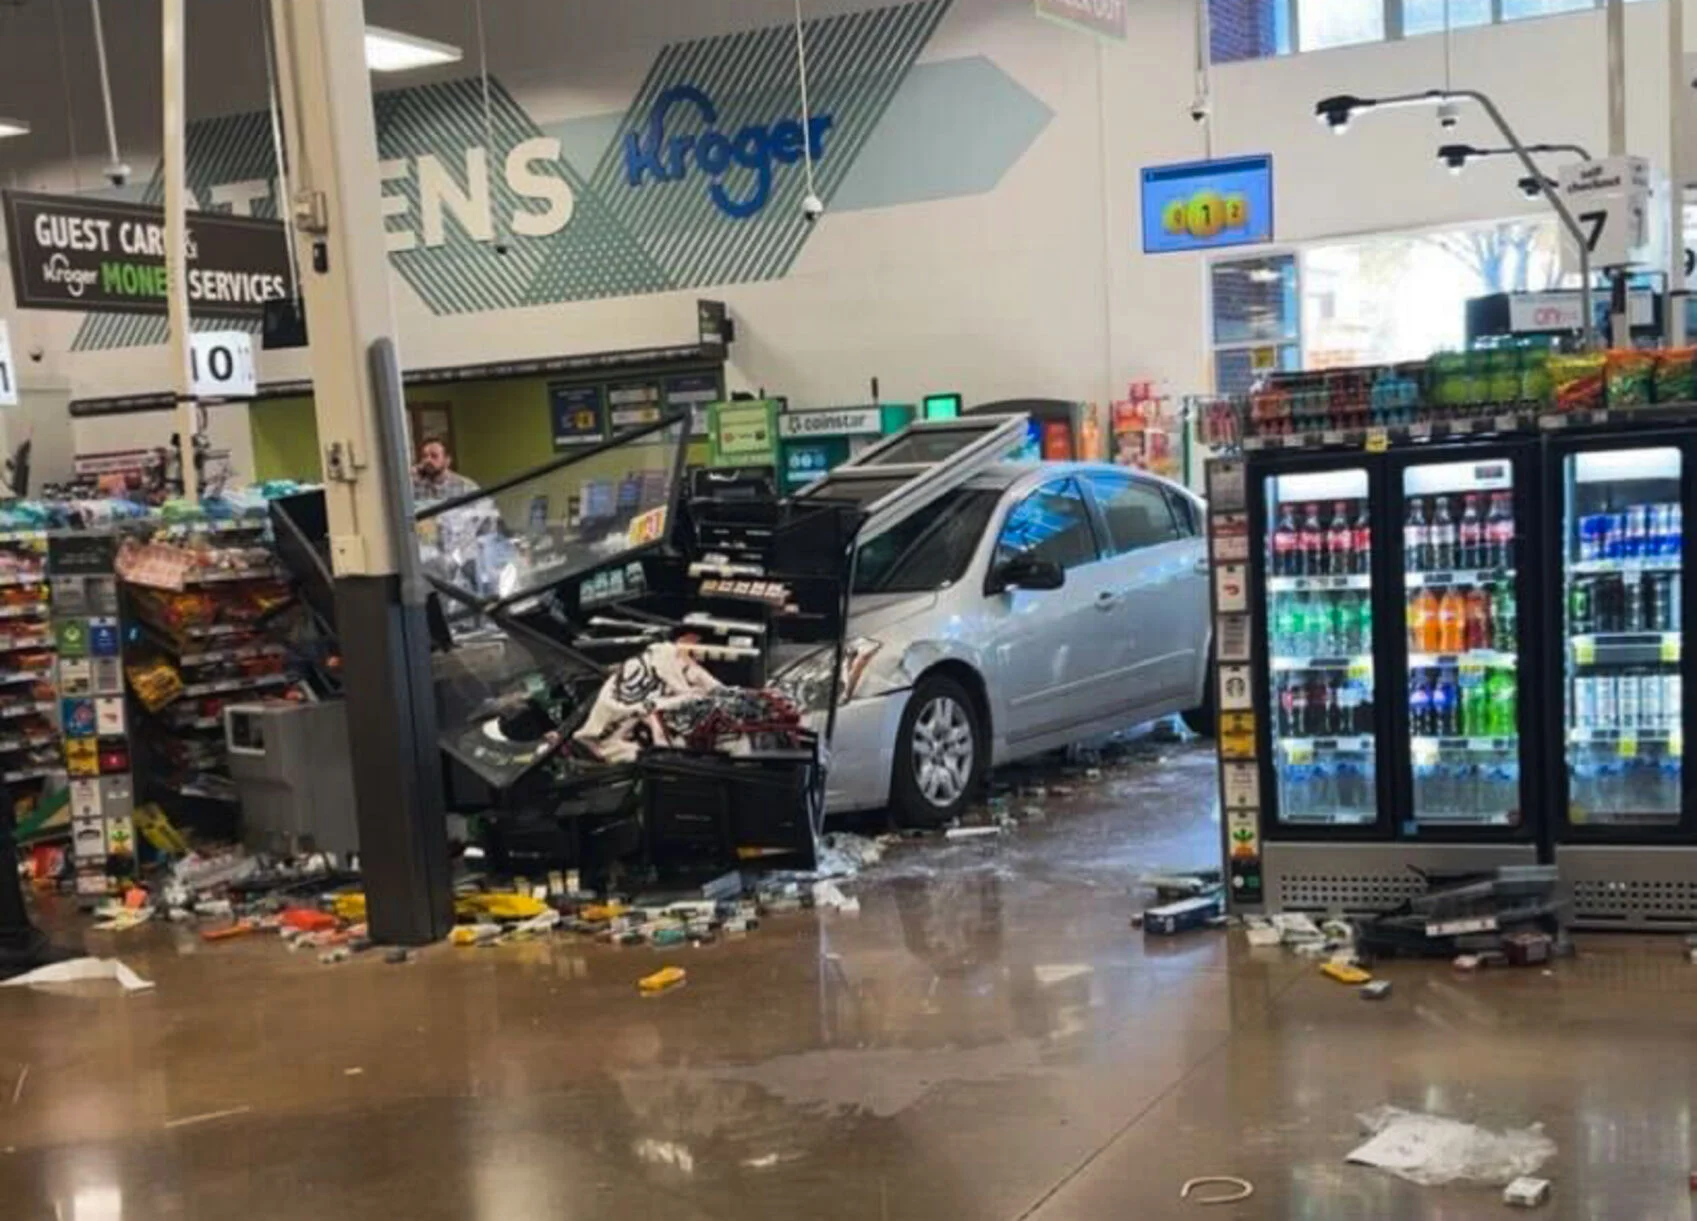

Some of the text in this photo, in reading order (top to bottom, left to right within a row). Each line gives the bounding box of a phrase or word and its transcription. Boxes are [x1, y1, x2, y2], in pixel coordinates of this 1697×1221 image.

[626, 84, 833, 219] Kroger
[35, 212, 111, 252] GUEST
[119, 221, 166, 256] CAR
[1579, 209, 1607, 252] 7
[42, 252, 286, 303] Kroger MONE SERVICES
[190, 345, 233, 382] 10
[804, 413, 867, 432] coinstar
